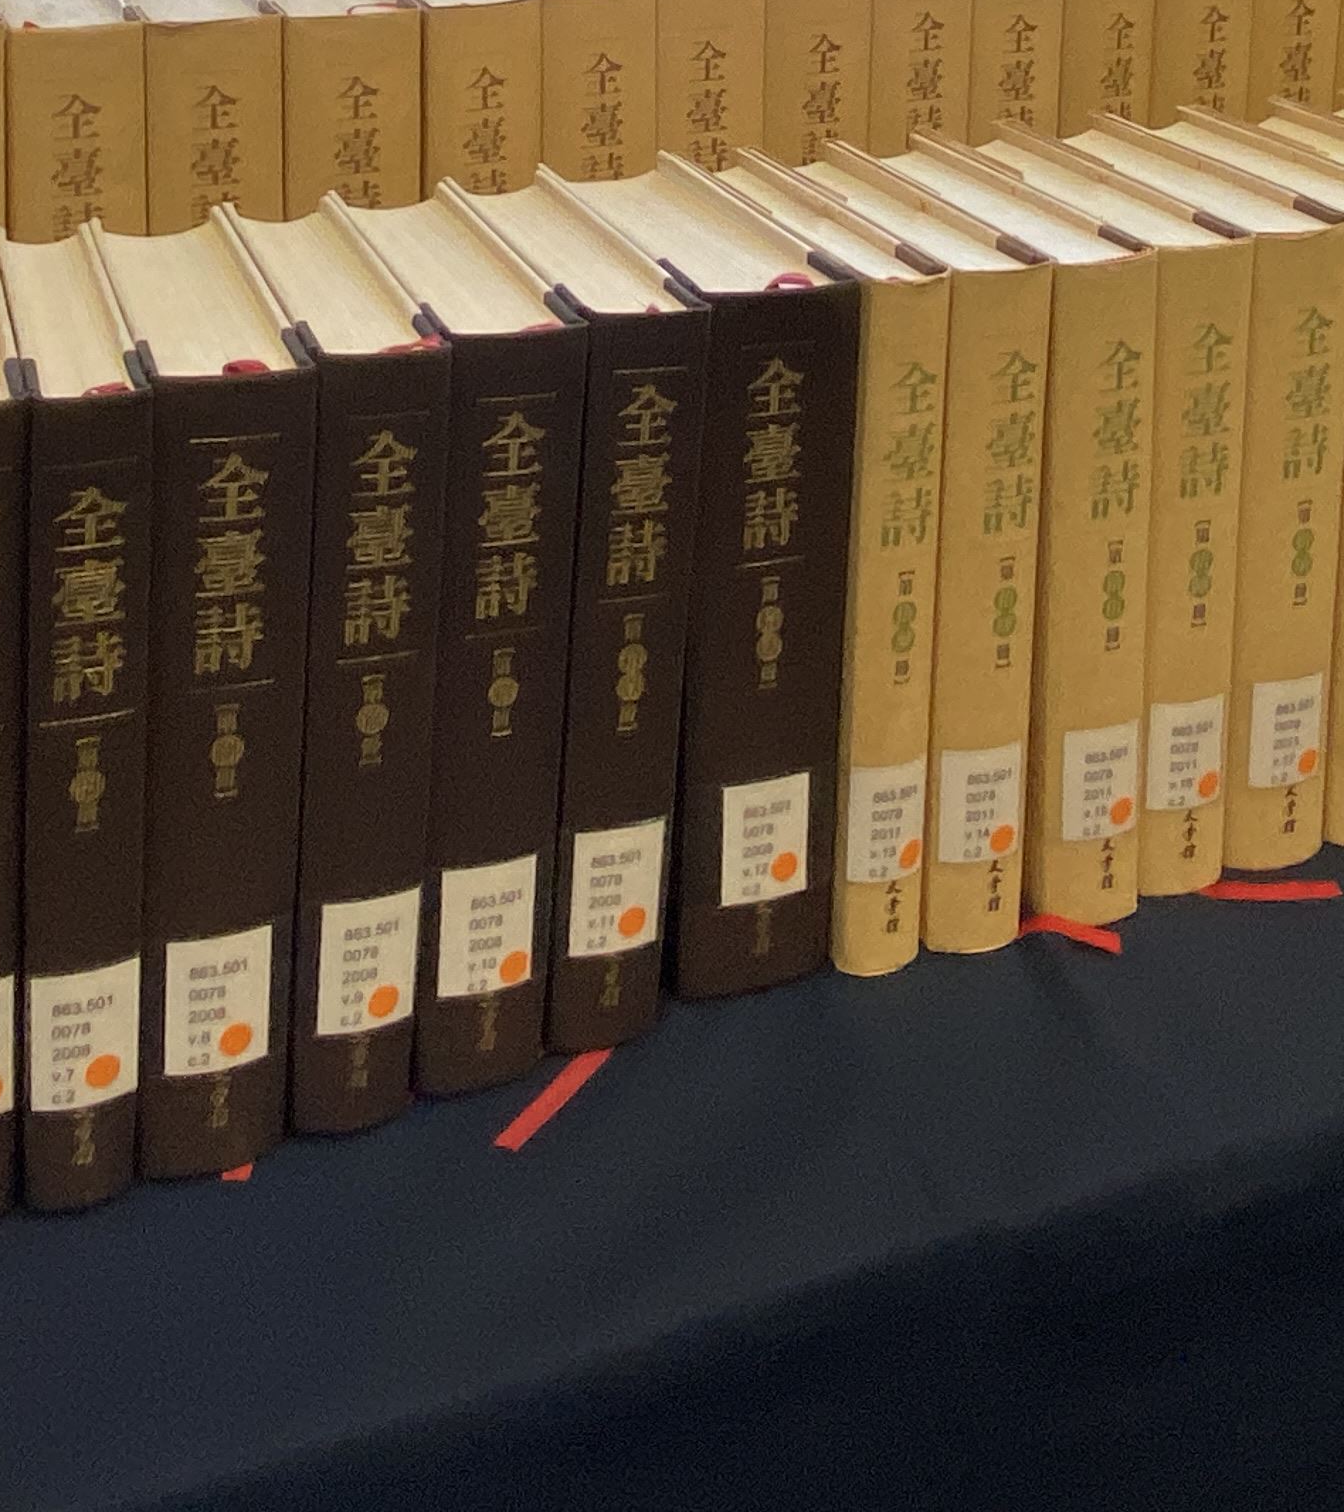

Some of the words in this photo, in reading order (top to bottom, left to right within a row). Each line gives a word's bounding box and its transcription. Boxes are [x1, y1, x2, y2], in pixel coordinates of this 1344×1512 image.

[606, 383, 678, 587] 全臺詩
[742, 356, 805, 550] 全臺詩
[879, 361, 937, 551] 全臺詩
[982, 349, 1038, 537] 全臺詩
[1090, 339, 1142, 521] 全臺詩
[1178, 322, 1233, 500] 全臺詩
[1282, 305, 1335, 479] 全臺詩
[52, 486, 128, 704] 全臺詩
[194, 453, 270, 675] 全臺詩
[343, 429, 418, 646] 全臺詩
[475, 410, 547, 621] 全臺詩
